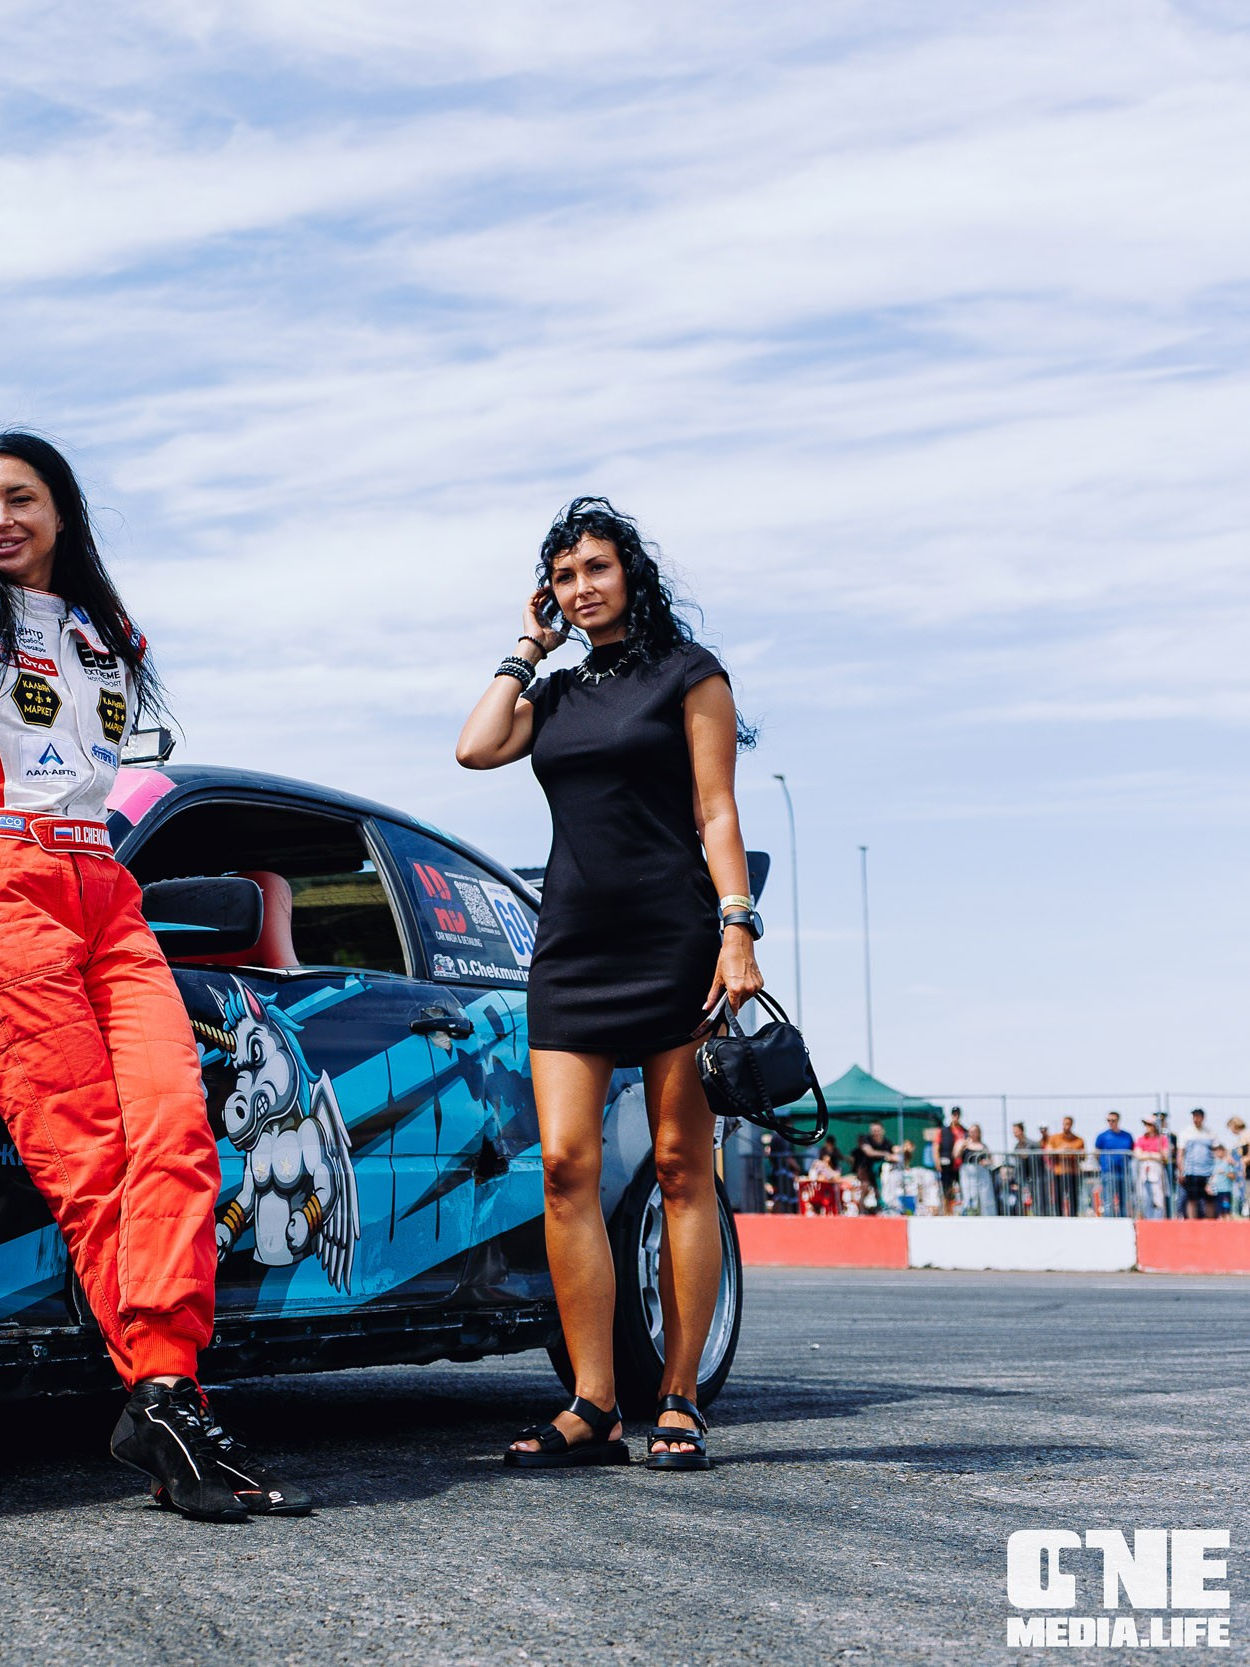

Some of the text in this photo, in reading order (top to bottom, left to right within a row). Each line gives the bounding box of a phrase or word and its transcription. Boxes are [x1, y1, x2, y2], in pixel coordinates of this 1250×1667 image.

[17, 627, 44, 641] ентр
[18, 654, 56, 672] TOTAL
[84, 668, 121, 680] EXTREME
[22, 681, 50, 693] КАЛЬЯН
[24, 705, 53, 717] МАРКЕТ
